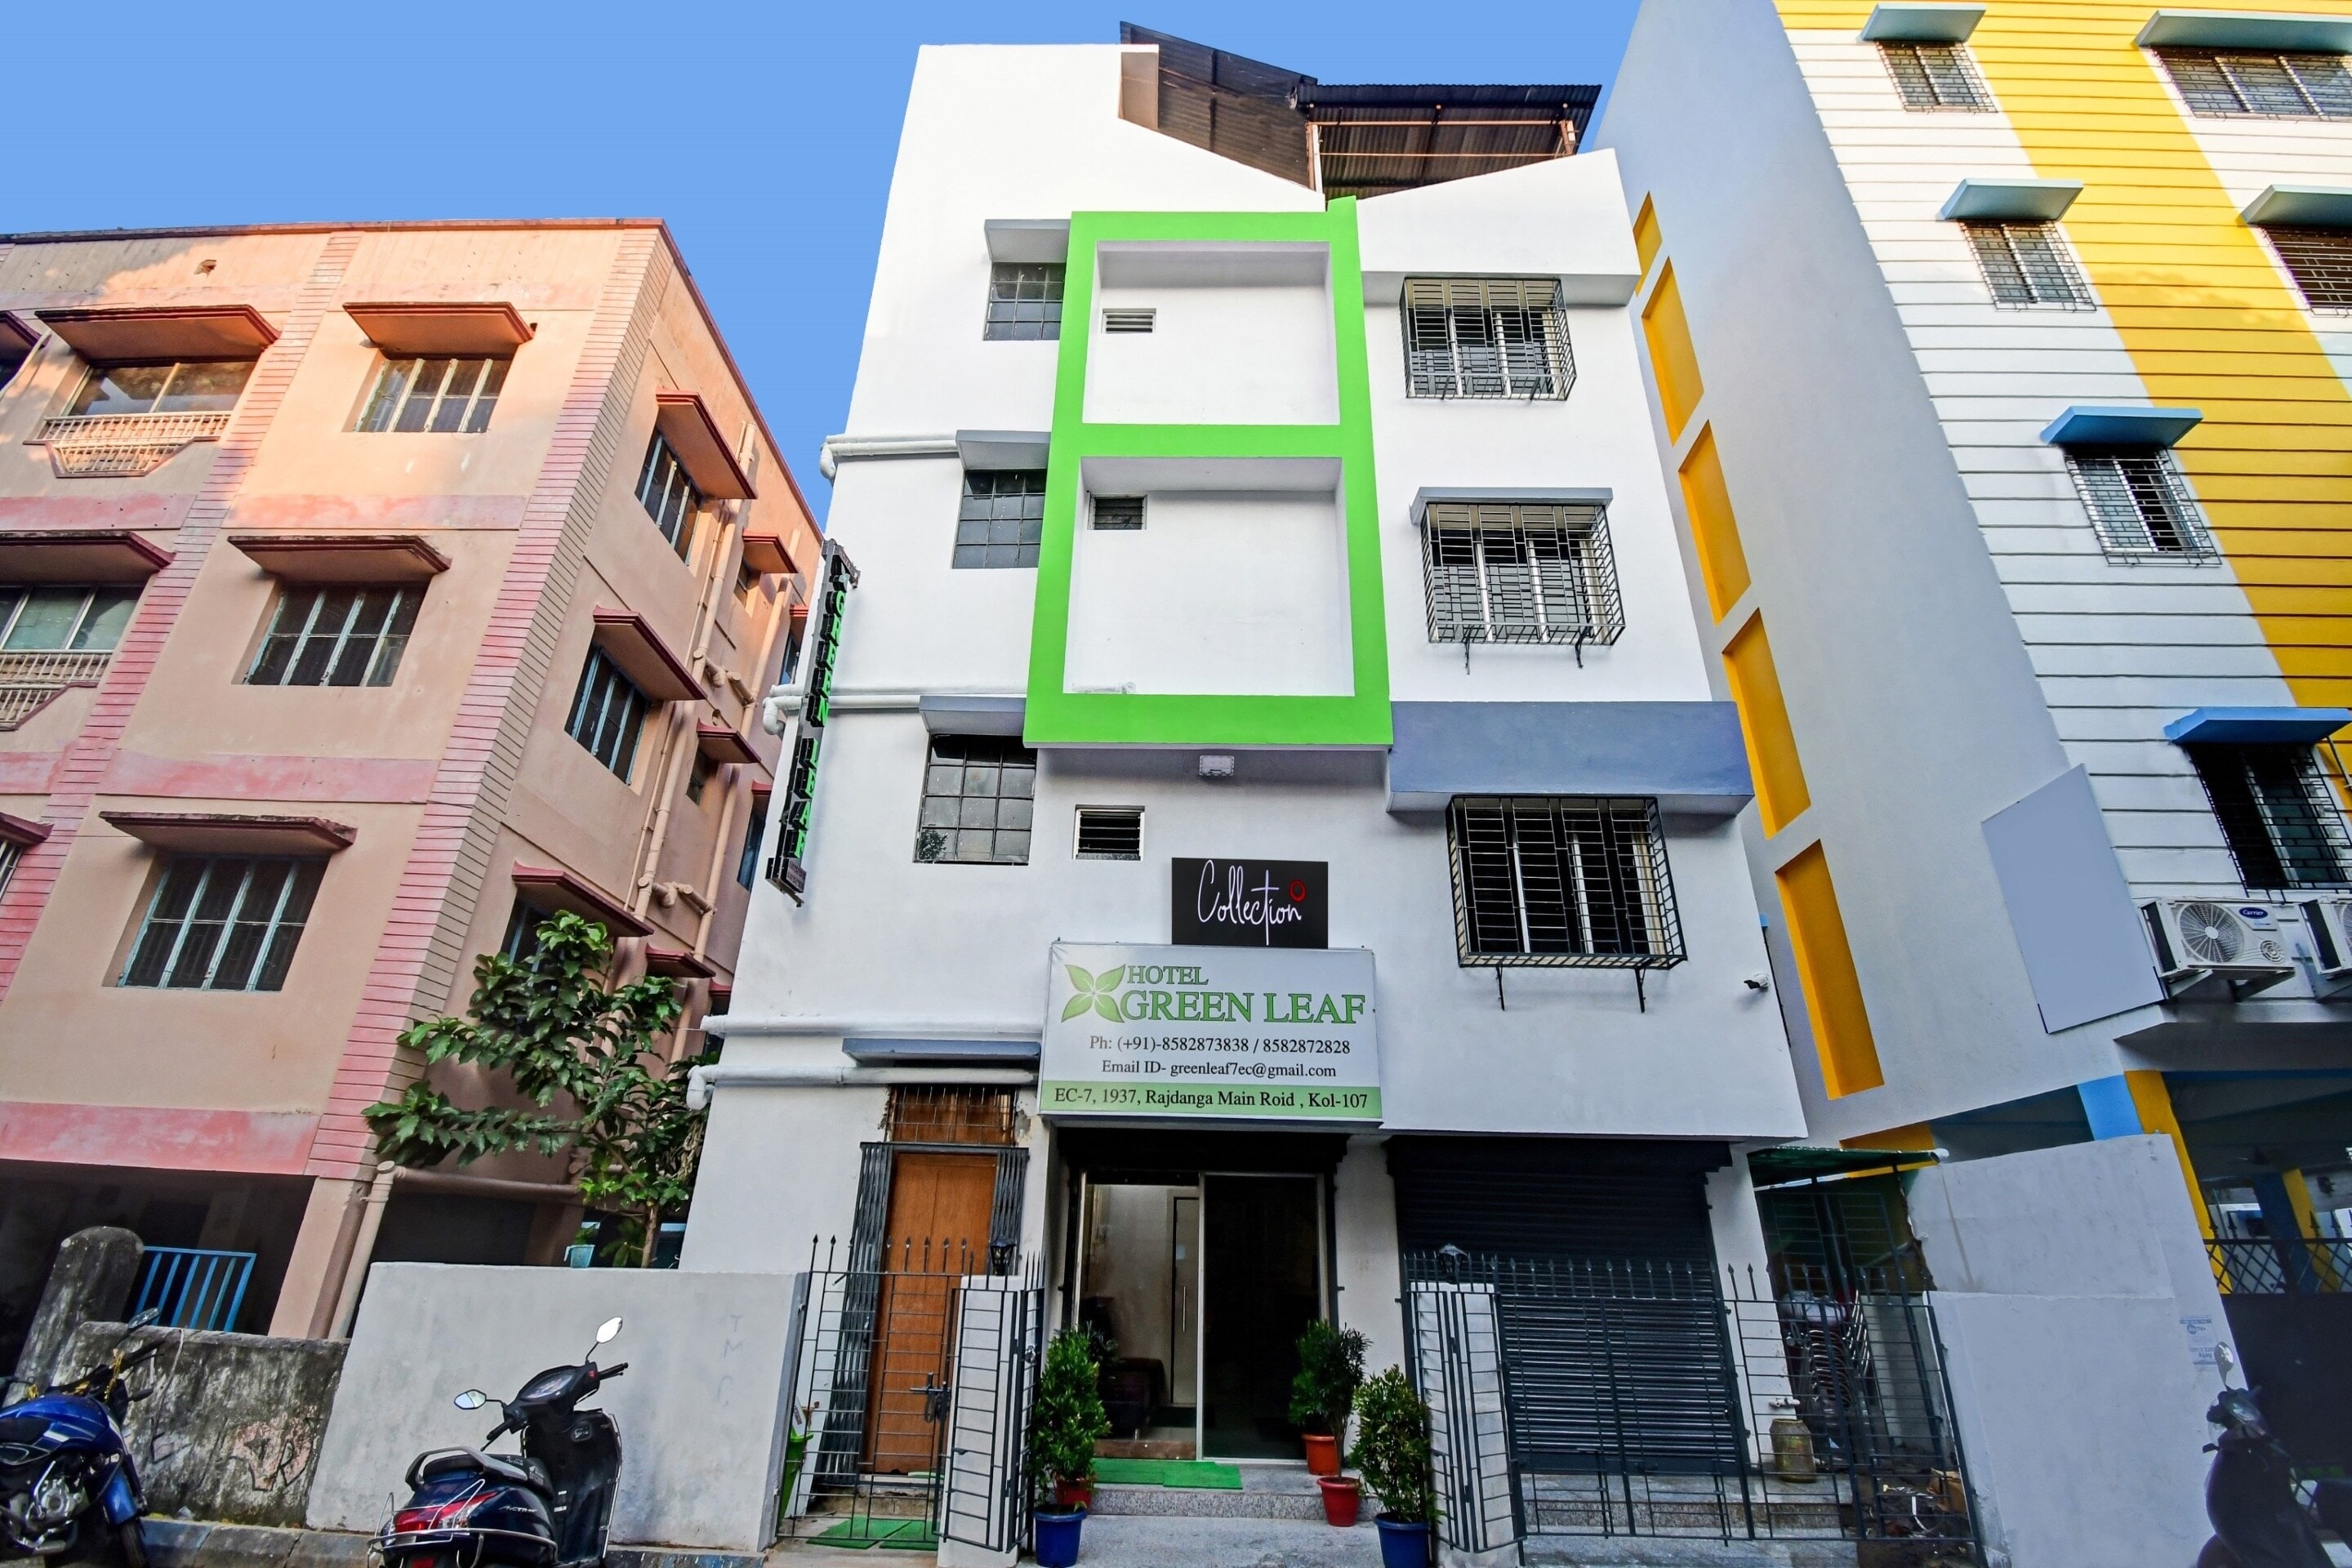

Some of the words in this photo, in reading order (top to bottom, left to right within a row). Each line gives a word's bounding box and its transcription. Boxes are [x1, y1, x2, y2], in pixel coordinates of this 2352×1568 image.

[1197, 859, 1302, 946] Collection
[1127, 965, 1209, 985] HOTEL
[1120, 990, 1254, 1022] GREEN
[1263, 992, 1365, 1024] LEAF
[1089, 1036, 1111, 1049] Ph:
[1117, 1036, 1249, 1053] (+91)-8582873838
[1253, 1038, 1259, 1054] /
[1263, 1039, 1351, 1054] 8582872828
[1102, 1060, 1139, 1073] Email
[1144, 1061, 1166, 1074] ID-
[1170, 1062, 1337, 1079] greenleaf7ec@gmail.com
[1054, 1088, 1096, 1104] EC-7,
[1102, 1089, 1141, 1106] 1937,
[1146, 1089, 1213, 1108] Rajdanga
[1218, 1091, 1255, 1106] Main
[1308, 1093, 1368, 1108] Kol-107
